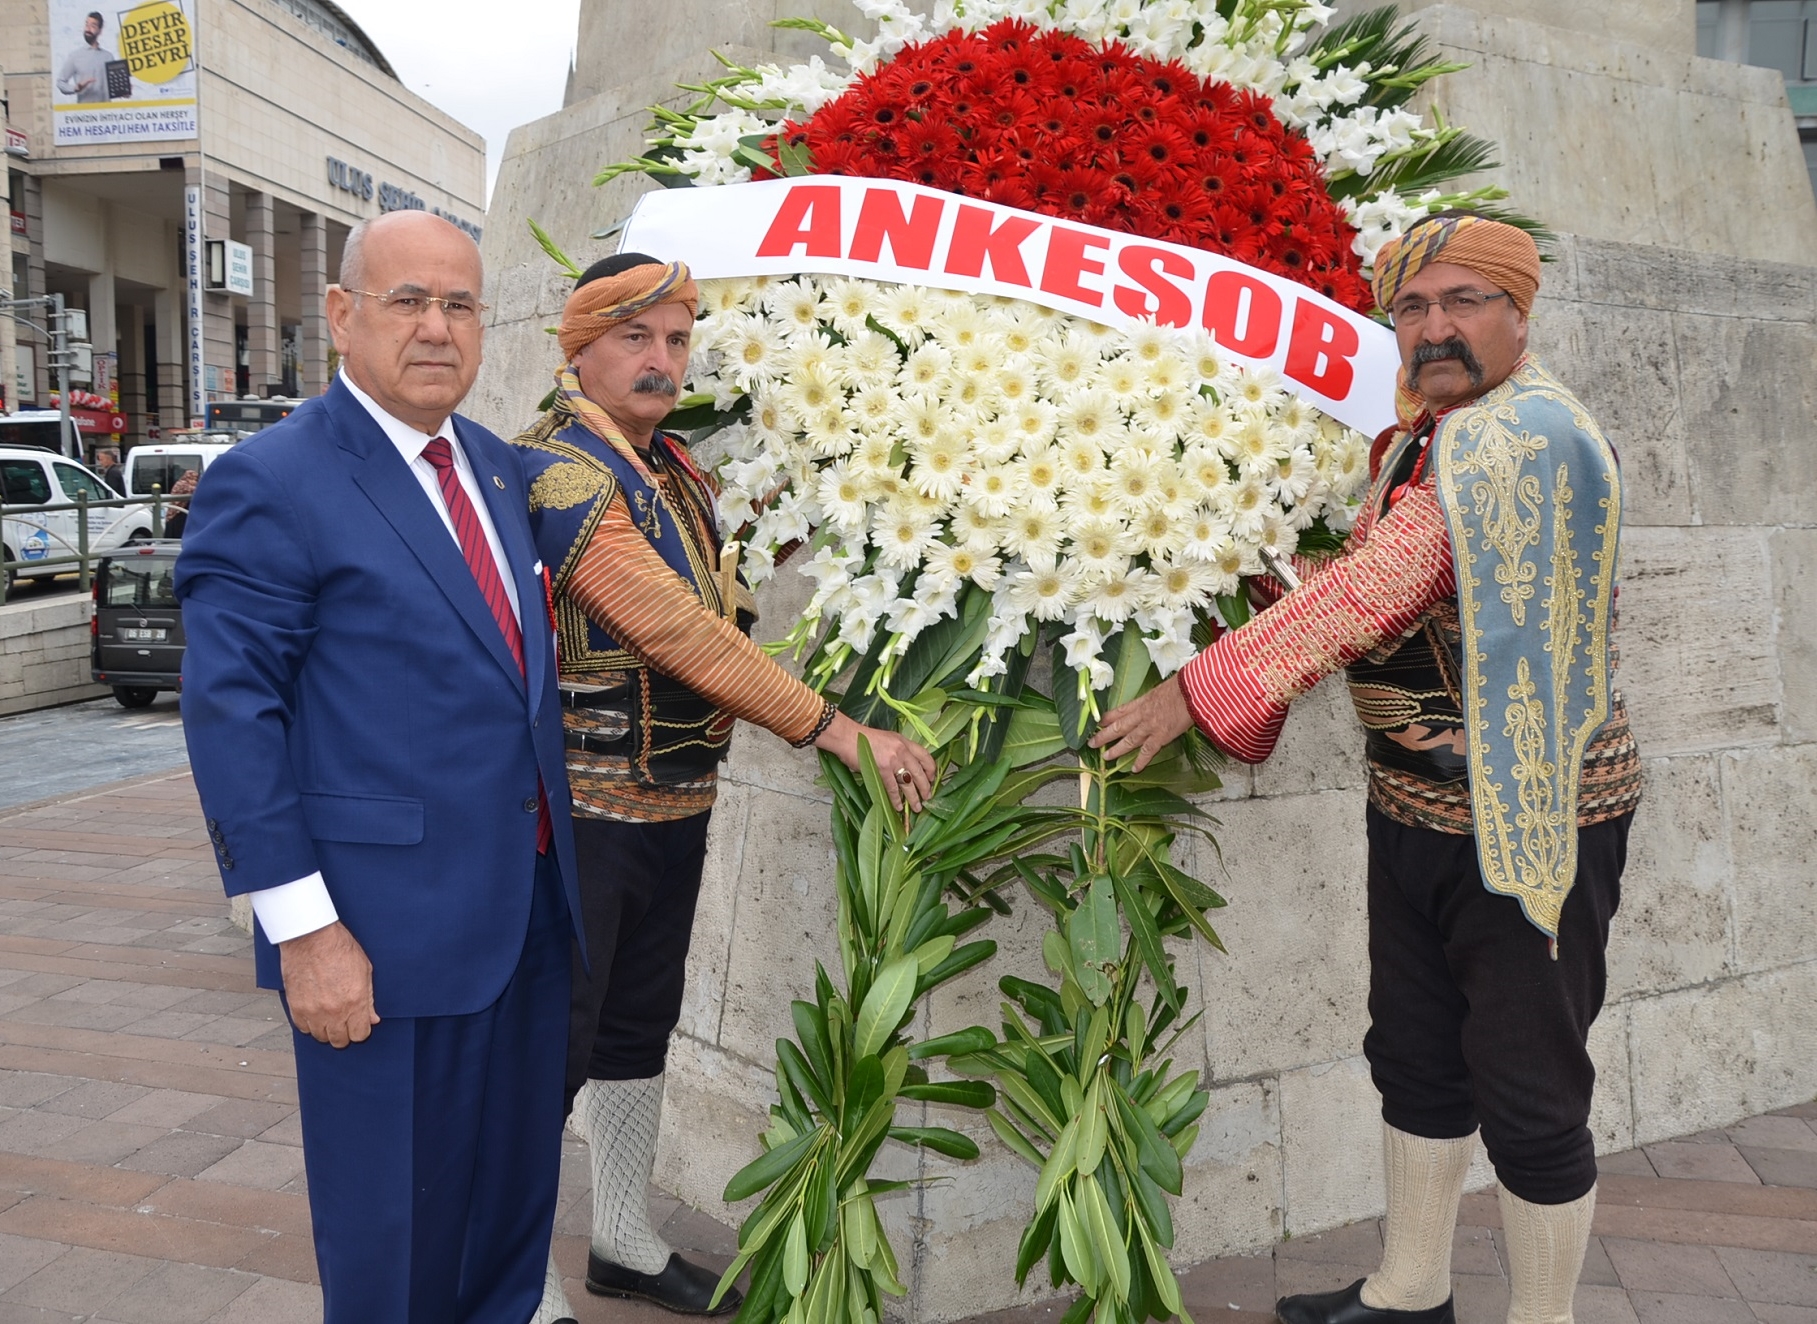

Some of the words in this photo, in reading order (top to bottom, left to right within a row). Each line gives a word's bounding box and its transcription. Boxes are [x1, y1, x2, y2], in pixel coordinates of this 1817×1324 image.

[123, 11, 184, 40] DEVİR
[125, 28, 186, 56] HESAP
[129, 43, 192, 73] DEVRİ
[58, 126, 82, 137] HEM
[84, 123, 125, 136] HESAPLI
[127, 122, 150, 134] HEM
[135, 111, 158, 120] OLAN
[327, 156, 374, 201] ULUS
[188, 193, 197, 244] ULUS
[189, 250, 199, 318] ŞEHİR
[755, 185, 1359, 401] ANKESOB
